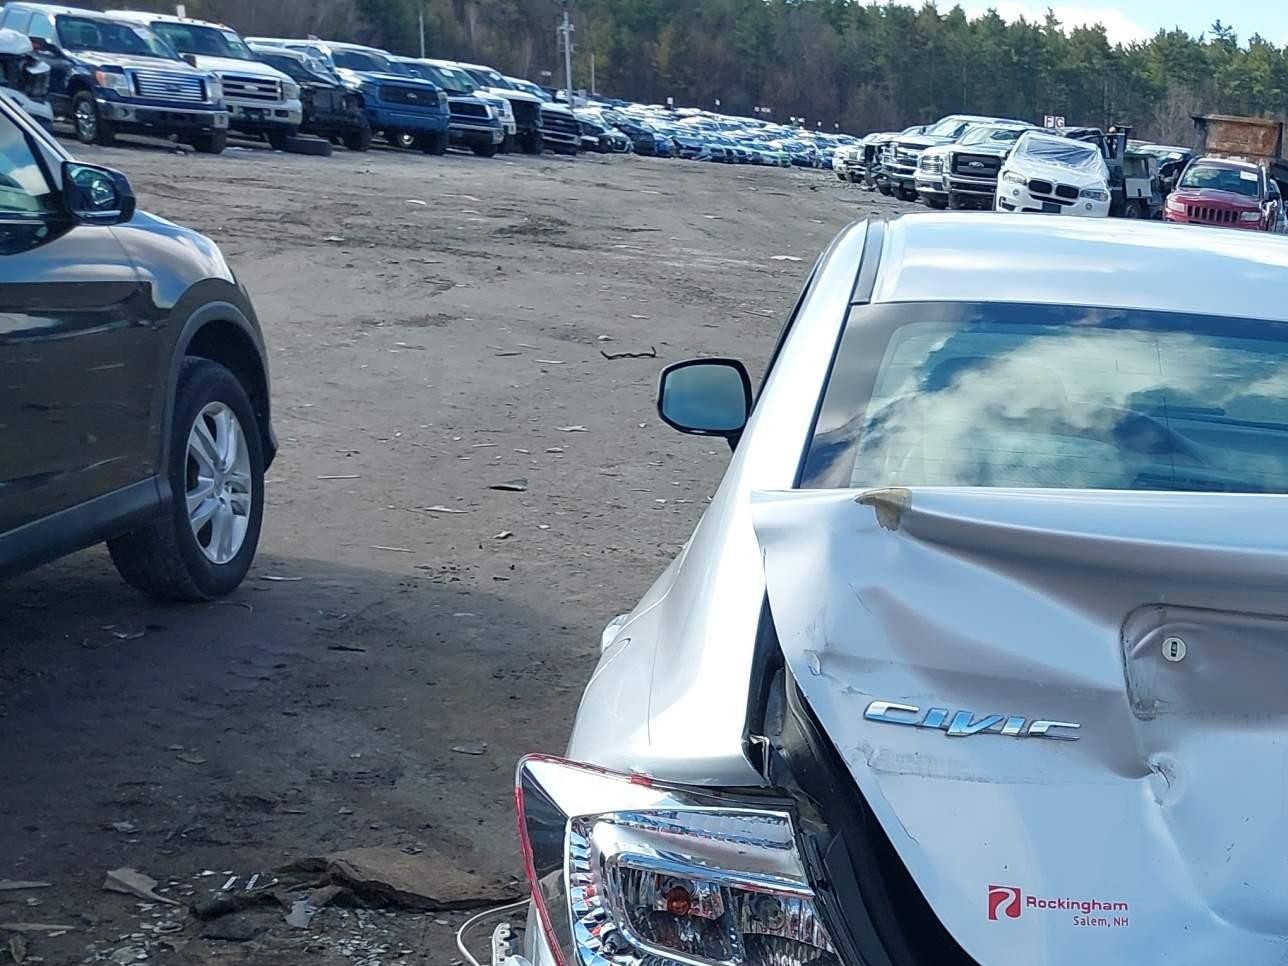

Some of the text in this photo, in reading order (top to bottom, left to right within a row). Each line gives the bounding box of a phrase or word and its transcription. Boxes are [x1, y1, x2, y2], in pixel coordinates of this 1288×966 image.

[863, 700, 1081, 741] CIVIC
[1026, 896, 1129, 914] Rockingham
[1073, 916, 1129, 927] Salem, NH
